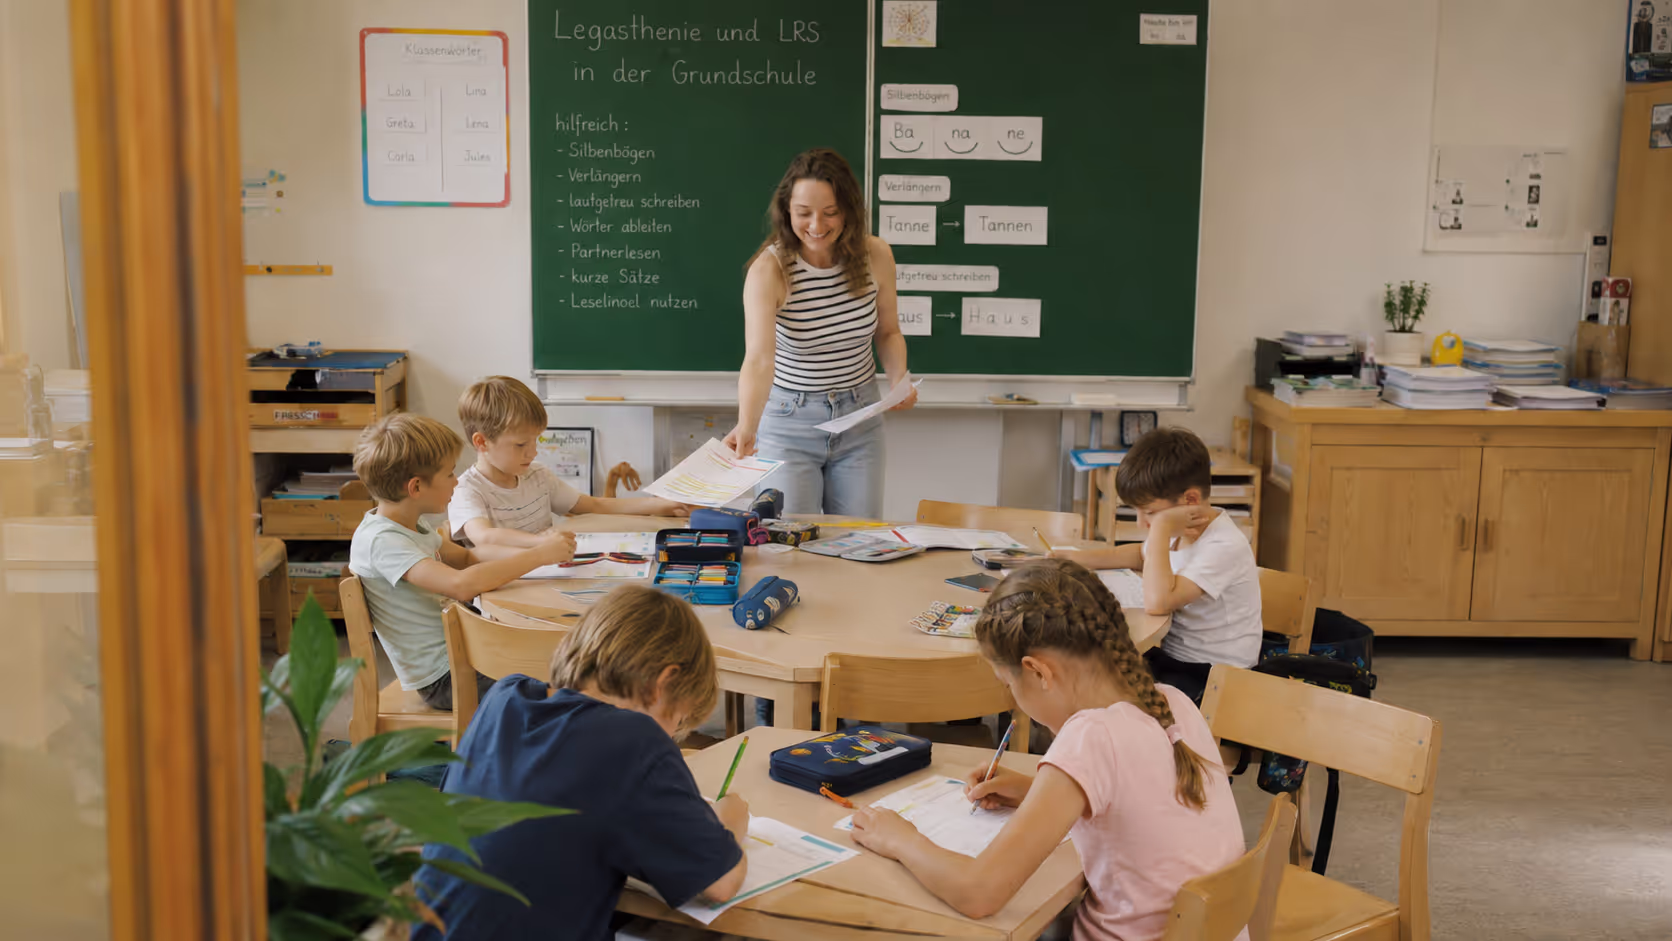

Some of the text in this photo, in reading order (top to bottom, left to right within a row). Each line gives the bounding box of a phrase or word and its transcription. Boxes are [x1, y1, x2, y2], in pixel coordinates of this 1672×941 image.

[554, 9, 820, 51] Legasthenie und LRS
[573, 57, 817, 86] in der Grundschule
[387, 83, 412, 97] Lola
[385, 116, 416, 130] Greta
[893, 121, 1026, 141] Ba na ne
[568, 141, 656, 166] Silbenbögen
[567, 167, 642, 189] Verlängern
[569, 192, 700, 215] lautgetreu schreiben
[569, 216, 673, 233] Wörter ableiten
[885, 215, 1033, 233] Tanne Tannen
[571, 242, 661, 260] Partnerlesen
[571, 267, 660, 284] kurze Sätze
[896, 270, 991, 284] utgetreu schreiben
[650, 293, 699, 309] nutzen
[897, 312, 923, 324] aus
